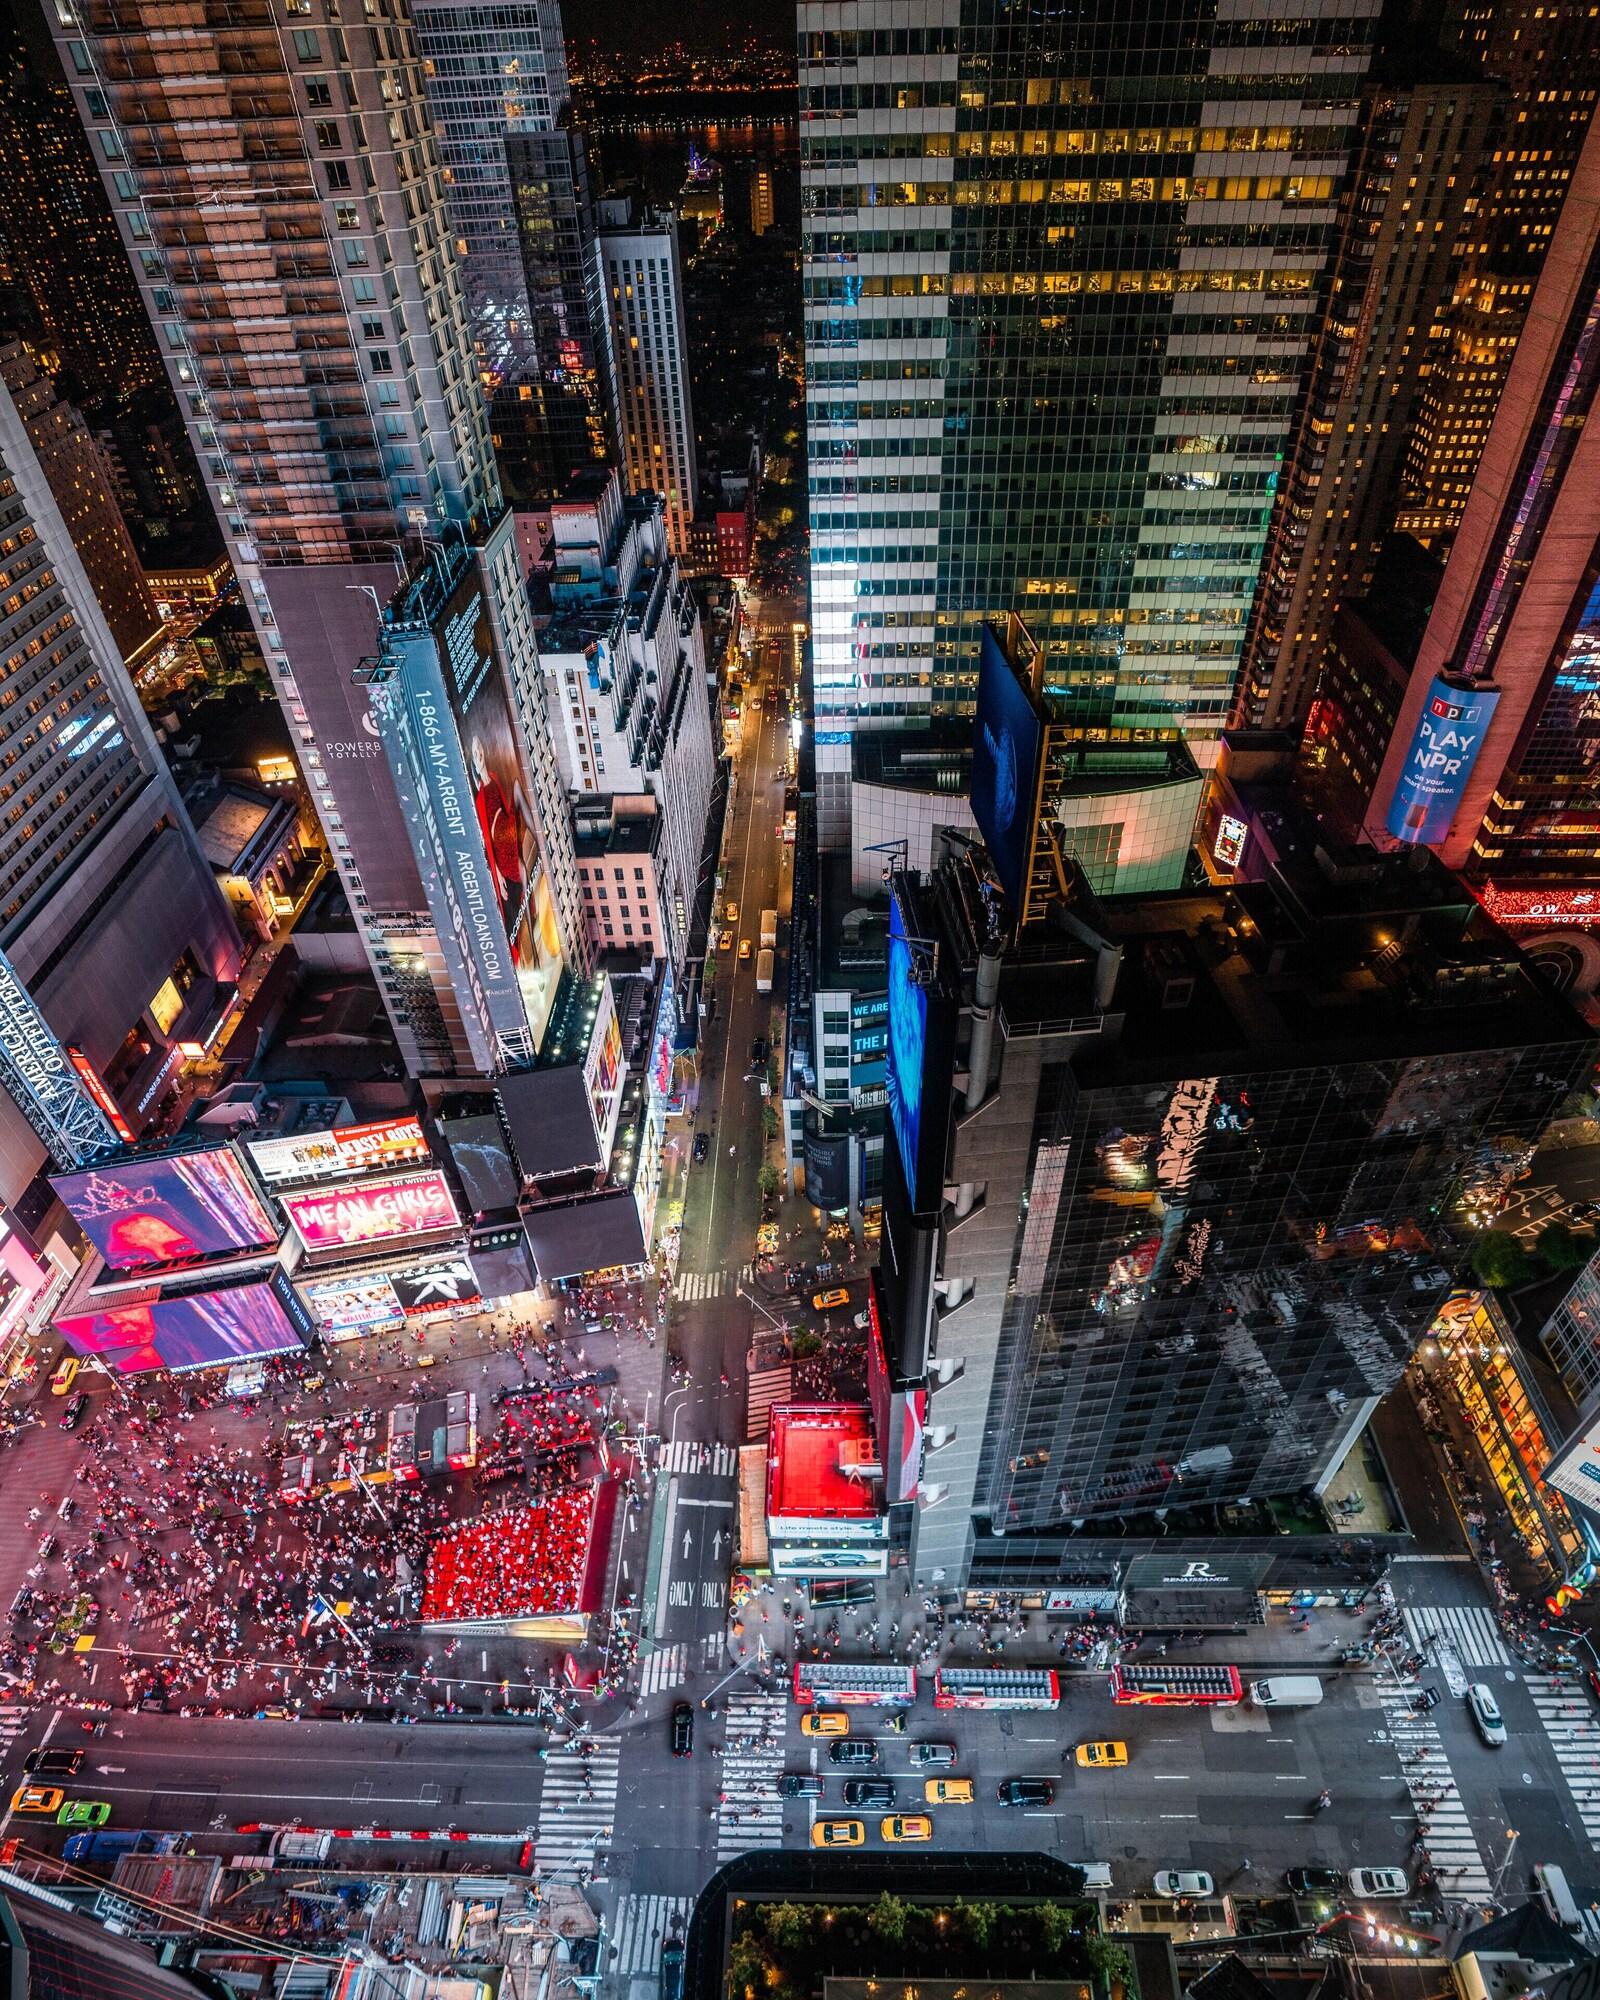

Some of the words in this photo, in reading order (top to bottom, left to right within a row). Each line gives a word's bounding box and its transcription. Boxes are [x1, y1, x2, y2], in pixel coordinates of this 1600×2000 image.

[1433, 701, 1476, 721] npr
[329, 751, 378, 759] TOTALLY
[1404, 775, 1420, 789] smart
[1421, 785, 1455, 794] speaker.
[1414, 774, 1424, 782] on
[1425, 777, 1446, 787] your
[415, 690, 467, 837] 1-866-MY-ARGENT
[455, 851, 503, 980] ARGENTLOANS.COM
[854, 1005, 869, 1016] WE
[870, 1002, 889, 1014] ARE
[854, 1035, 880, 1051] THE
[134, 1074, 164, 1114] MARQUIS
[335, 1132, 386, 1157] JERSEY
[388, 1122, 424, 1142] BOYS
[287, 1196, 306, 1204] YOU
[308, 1190, 336, 1201] KNOW
[339, 1186, 356, 1196] YOU
[357, 1182, 392, 1193] WANNA
[392, 1179, 403, 1187] SIT
[405, 1176, 426, 1185] WITH
[426, 1174, 439, 1182] US
[297, 1196, 370, 1230] MEAN
[373, 1185, 447, 1215] GIRLS
[277, 1276, 292, 1299] EAGLE
[290, 1298, 310, 1332] AMERICAN
[1181, 1562, 1217, 1577] R
[669, 1582, 696, 1607] ONLY
[701, 1582, 727, 1608] ONLY
